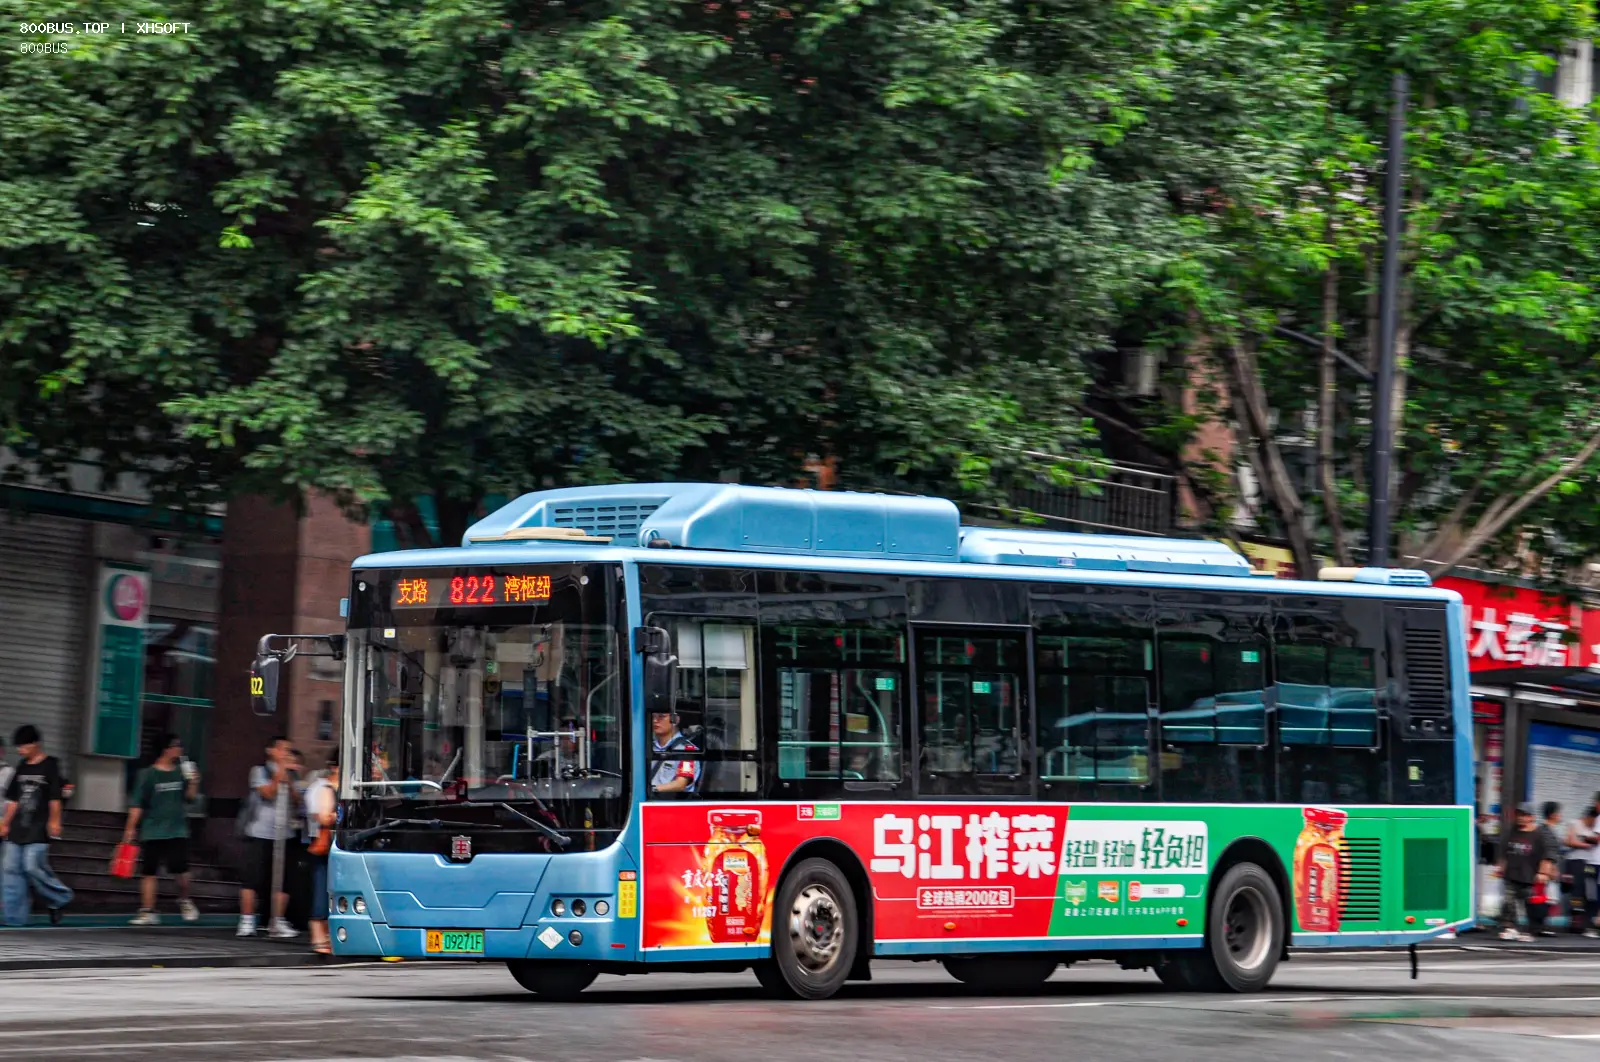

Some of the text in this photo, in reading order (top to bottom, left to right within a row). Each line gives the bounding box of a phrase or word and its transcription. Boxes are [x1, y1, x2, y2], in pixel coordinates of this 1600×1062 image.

[397, 575, 550, 604] 支路 822 湾枢纽
[870, 811, 1056, 879] 乌江榨菜
[1065, 827, 1205, 869] 轻盐 轻油 轻负担
[681, 868, 726, 889] 重庆公交
[921, 890, 1010, 906] 全球热销200亿包
